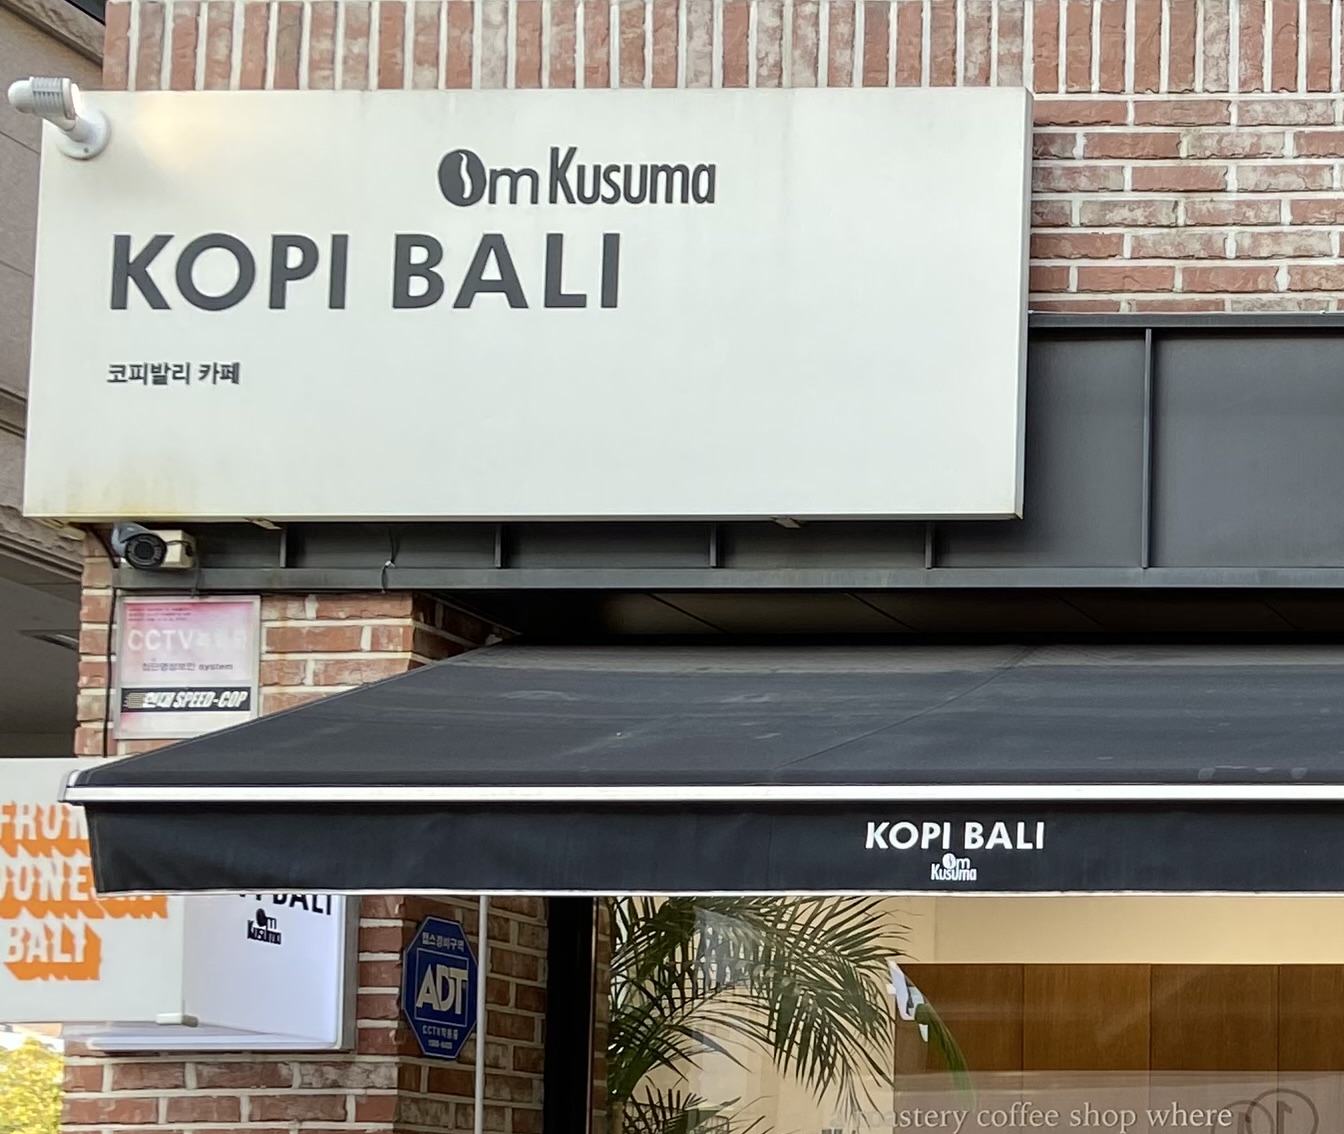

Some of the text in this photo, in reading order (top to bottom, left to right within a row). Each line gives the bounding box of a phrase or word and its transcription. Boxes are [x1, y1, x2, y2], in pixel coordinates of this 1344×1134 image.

[548, 147, 716, 205] Kusuma
[109, 232, 621, 312] KOPI BALI
[107, 361, 240, 387] 코피발리 카페
[173, 691, 248, 708] SPEED-COP
[866, 822, 1044, 849] KOPI BALI
[931, 863, 977, 881] Kusuma
[416, 964, 468, 1014] ADT
[976, 1102, 1059, 1128] coffee
[1069, 1102, 1137, 1134] shop
[1146, 1102, 1233, 1128] where
